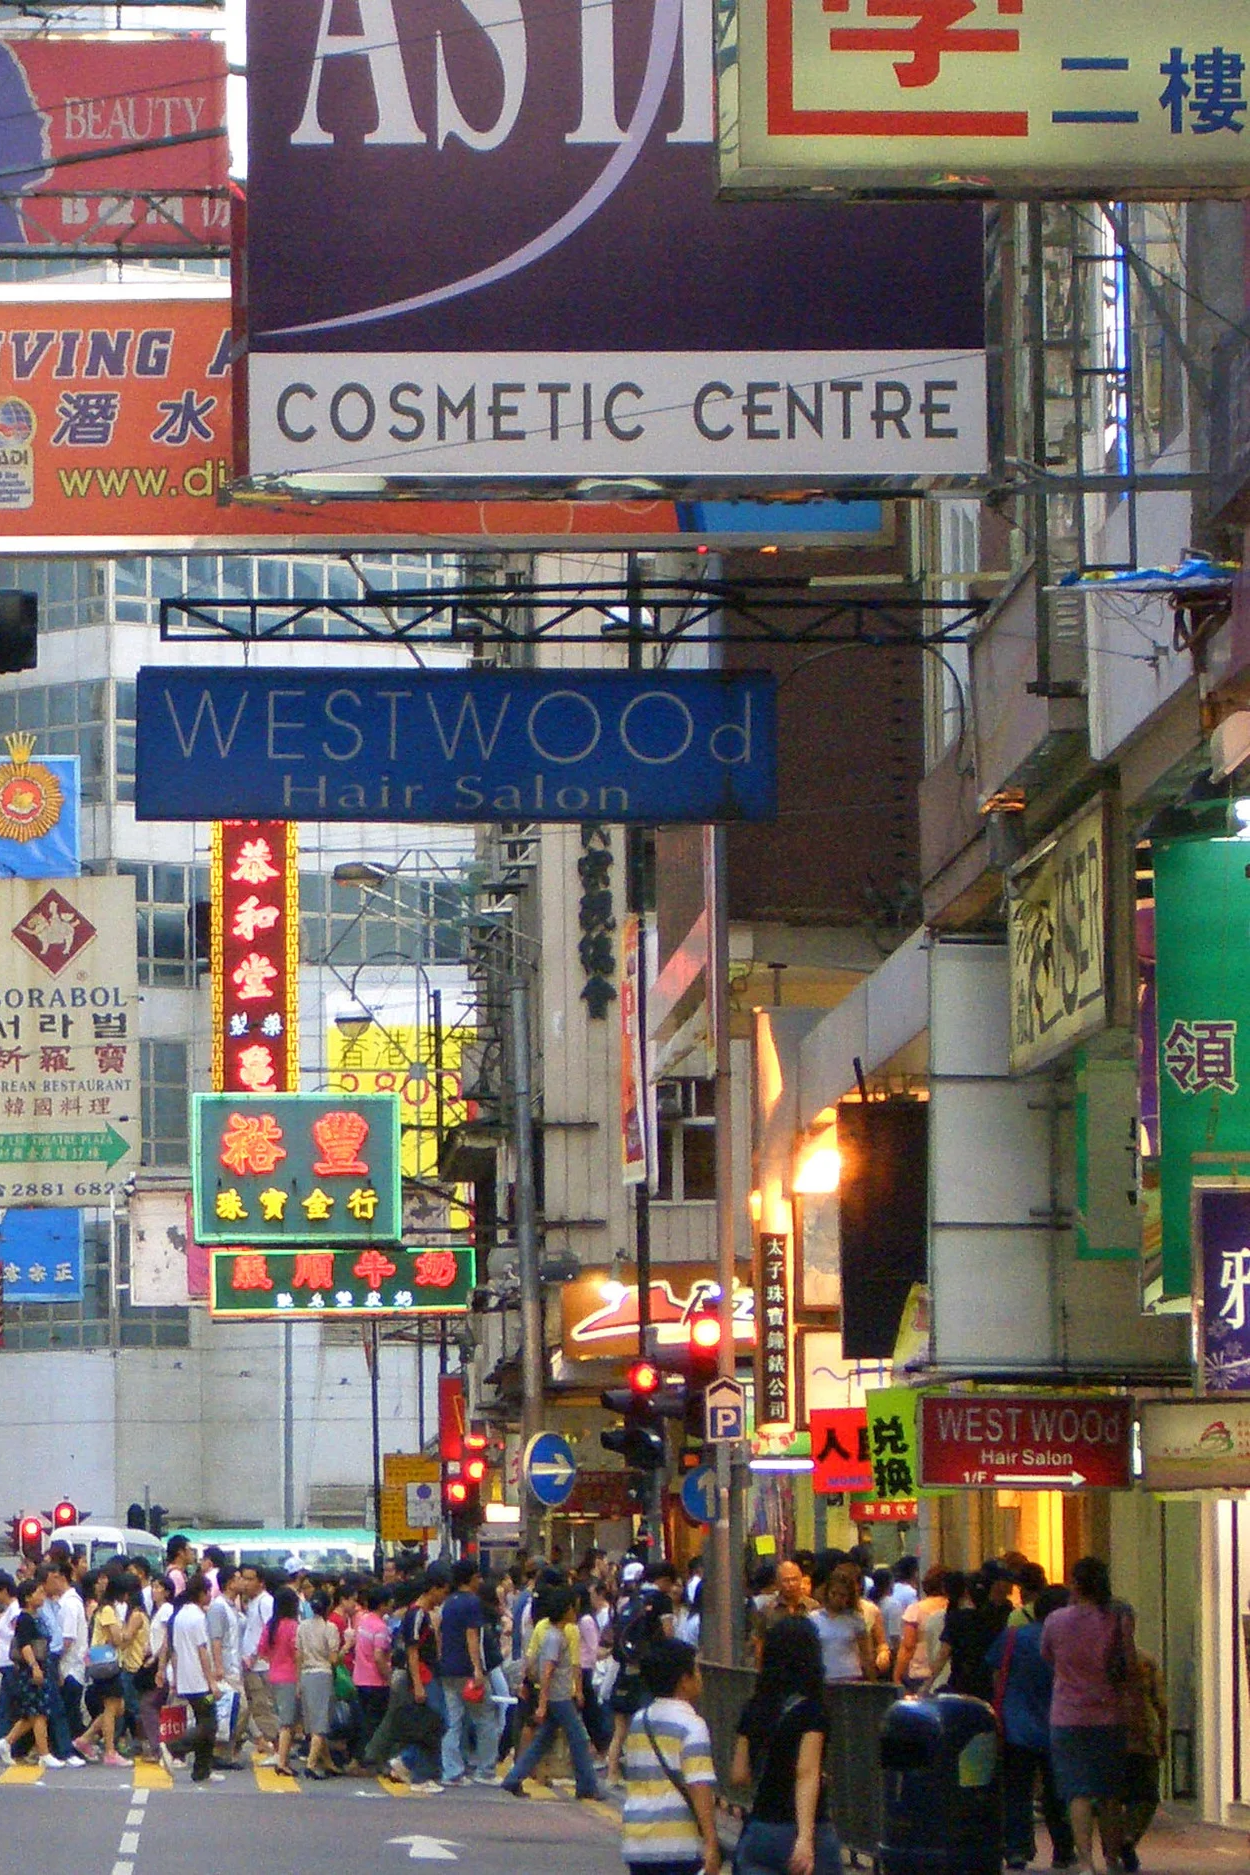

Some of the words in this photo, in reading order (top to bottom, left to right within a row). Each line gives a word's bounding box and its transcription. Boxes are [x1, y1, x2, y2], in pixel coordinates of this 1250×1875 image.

[1051, 46, 1249, 134] 二樓
[63, 97, 205, 140] BEAUTY
[276, 382, 646, 443] COSMETIC
[692, 380, 959, 440] CENTRE
[283, 774, 422, 811] Hair
[455, 772, 629, 811] Salon
[1165, 1019, 1239, 1095] 領
[43, 1079, 131, 1092] RESTAURANT
[12, 1183, 63, 1197] 2881
[716, 1408, 737, 1436] P
[937, 1408, 1021, 1442] WEST
[981, 1449, 1018, 1465] Hair
[1022, 1449, 1073, 1465] Salon
[962, 1471, 987, 1483] 1/F
